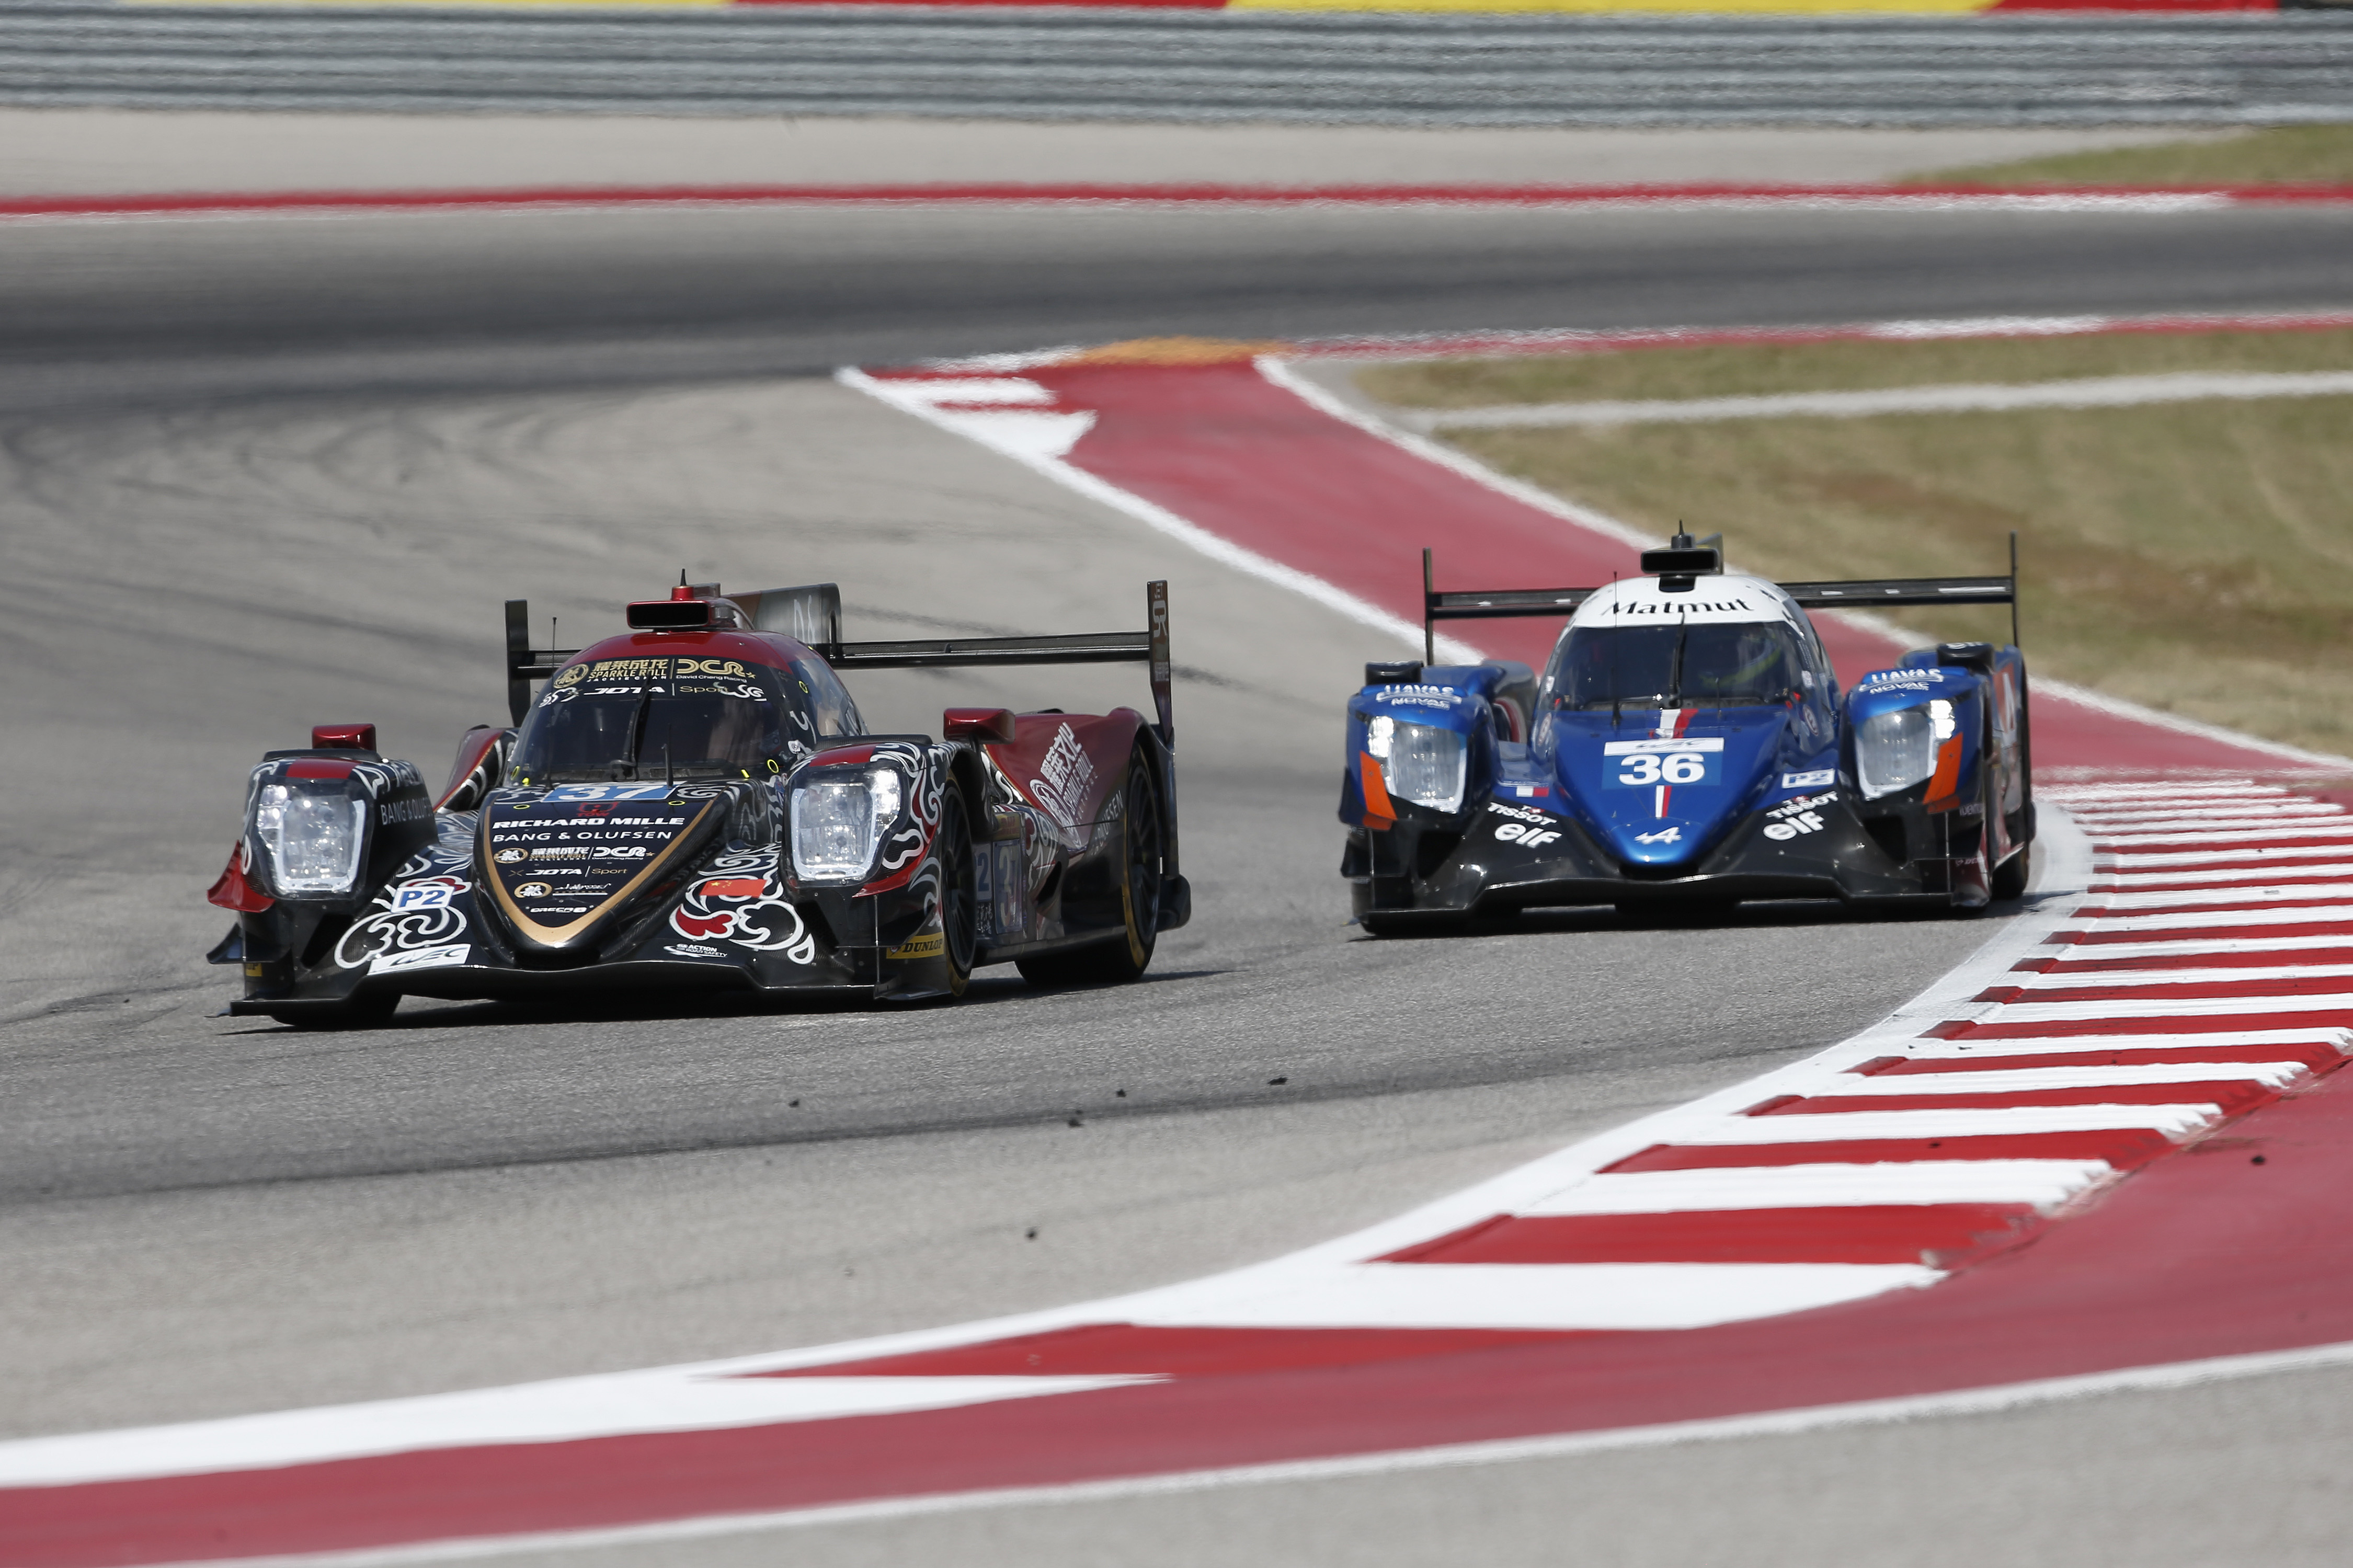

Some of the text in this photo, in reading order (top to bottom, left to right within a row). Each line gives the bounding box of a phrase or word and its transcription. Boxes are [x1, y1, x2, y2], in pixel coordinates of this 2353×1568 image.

[1601, 598, 1754, 616] Matmut
[589, 669, 637, 679] SPARKLE
[1619, 752, 1706, 785] 36
[1788, 772, 1828, 784] P2
[558, 785, 664, 800] 37
[1063, 768, 1084, 816] SPARKLE
[381, 800, 406, 825] BANG
[1487, 802, 1557, 826] TISSOT
[1765, 791, 1838, 819] TISSOT
[492, 818, 605, 829] RICHARD
[1763, 810, 1825, 841] elf
[493, 832, 552, 842] BANG
[577, 831, 673, 840] OLUFSEN
[1494, 823, 1562, 849] elf
[398, 890, 446, 908] P2
[902, 938, 943, 953] DUNLOP
